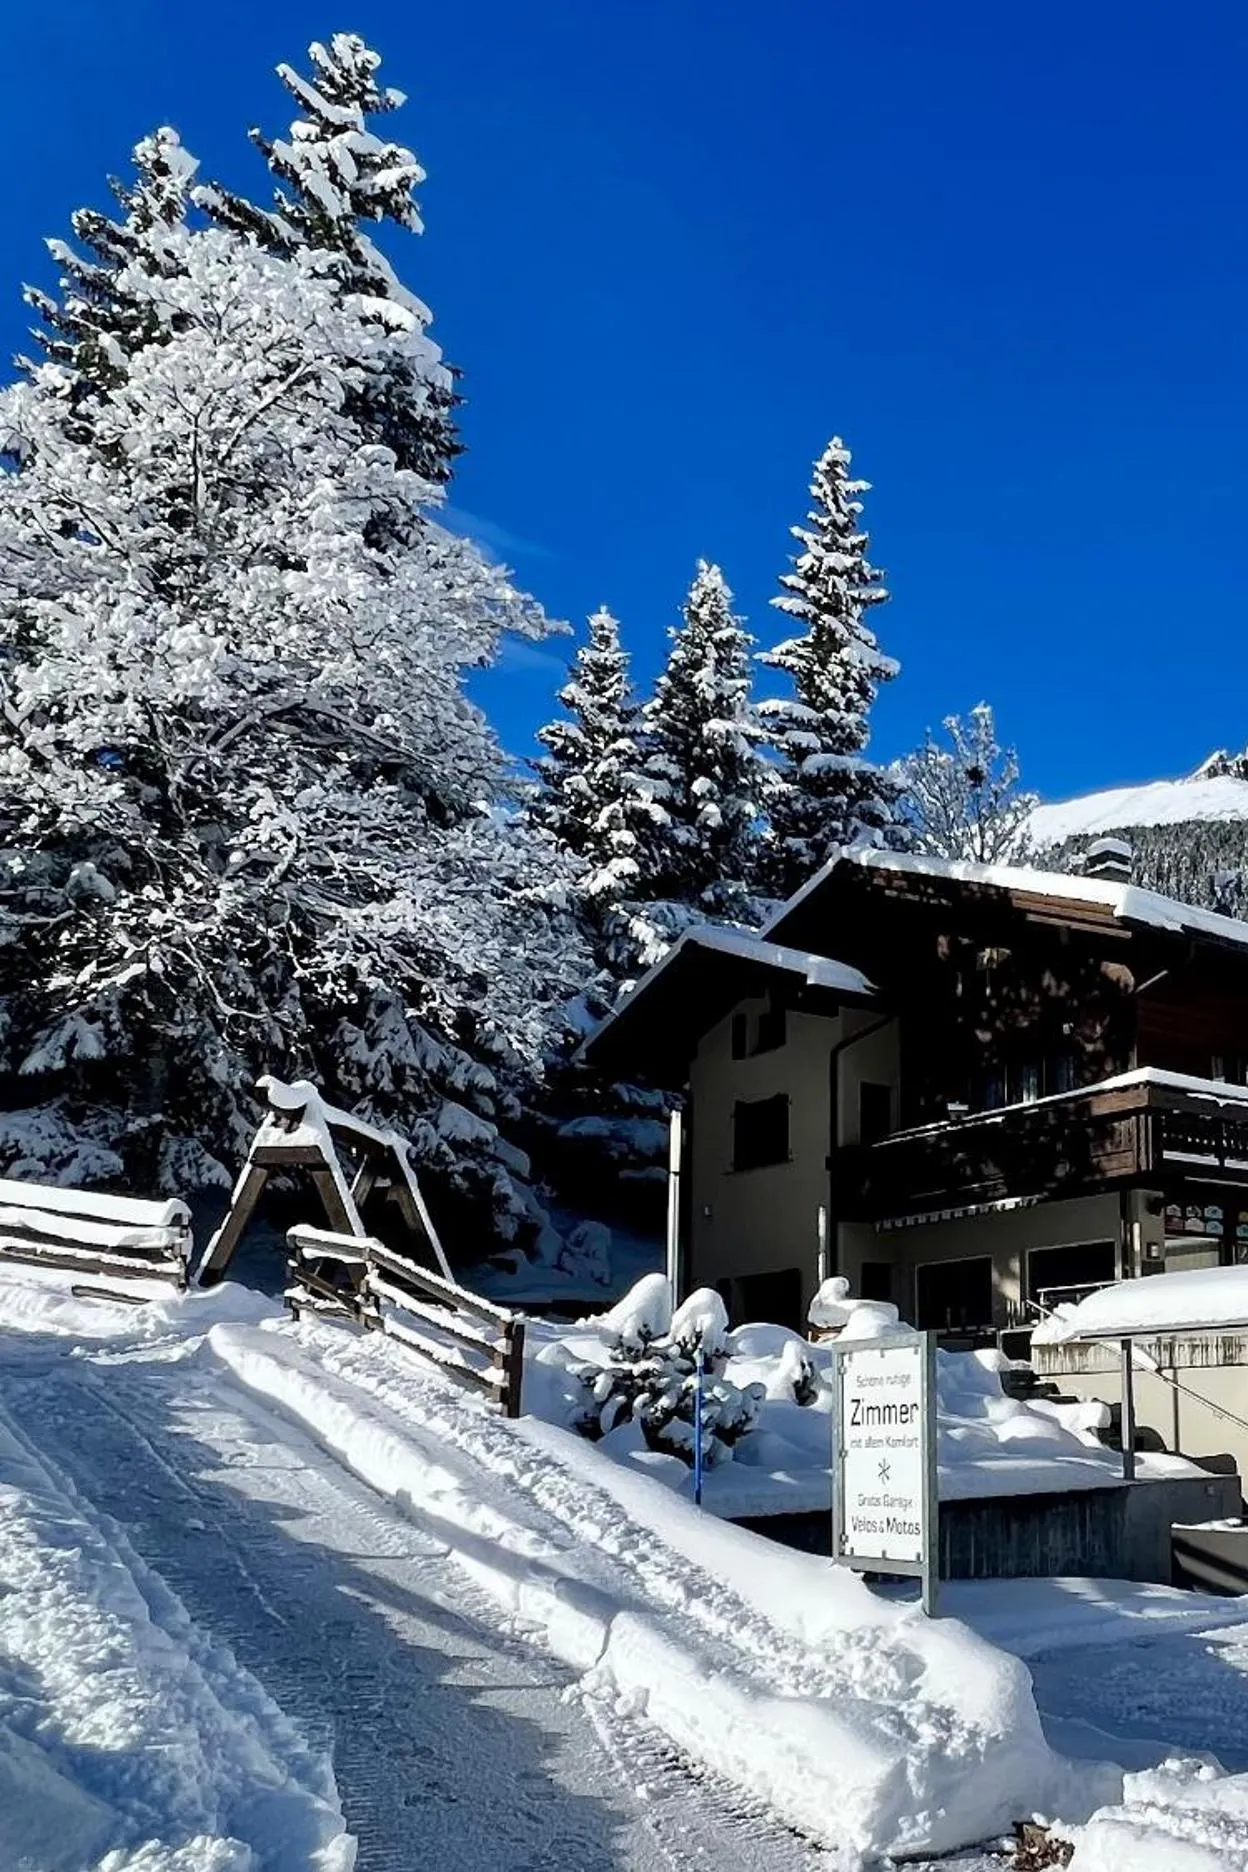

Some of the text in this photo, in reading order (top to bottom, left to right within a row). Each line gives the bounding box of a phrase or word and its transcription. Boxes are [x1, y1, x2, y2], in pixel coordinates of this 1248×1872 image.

[850, 1397, 919, 1427] Zimmer
[851, 1516, 878, 1534] Velos
[886, 1516, 921, 1536] Motos
